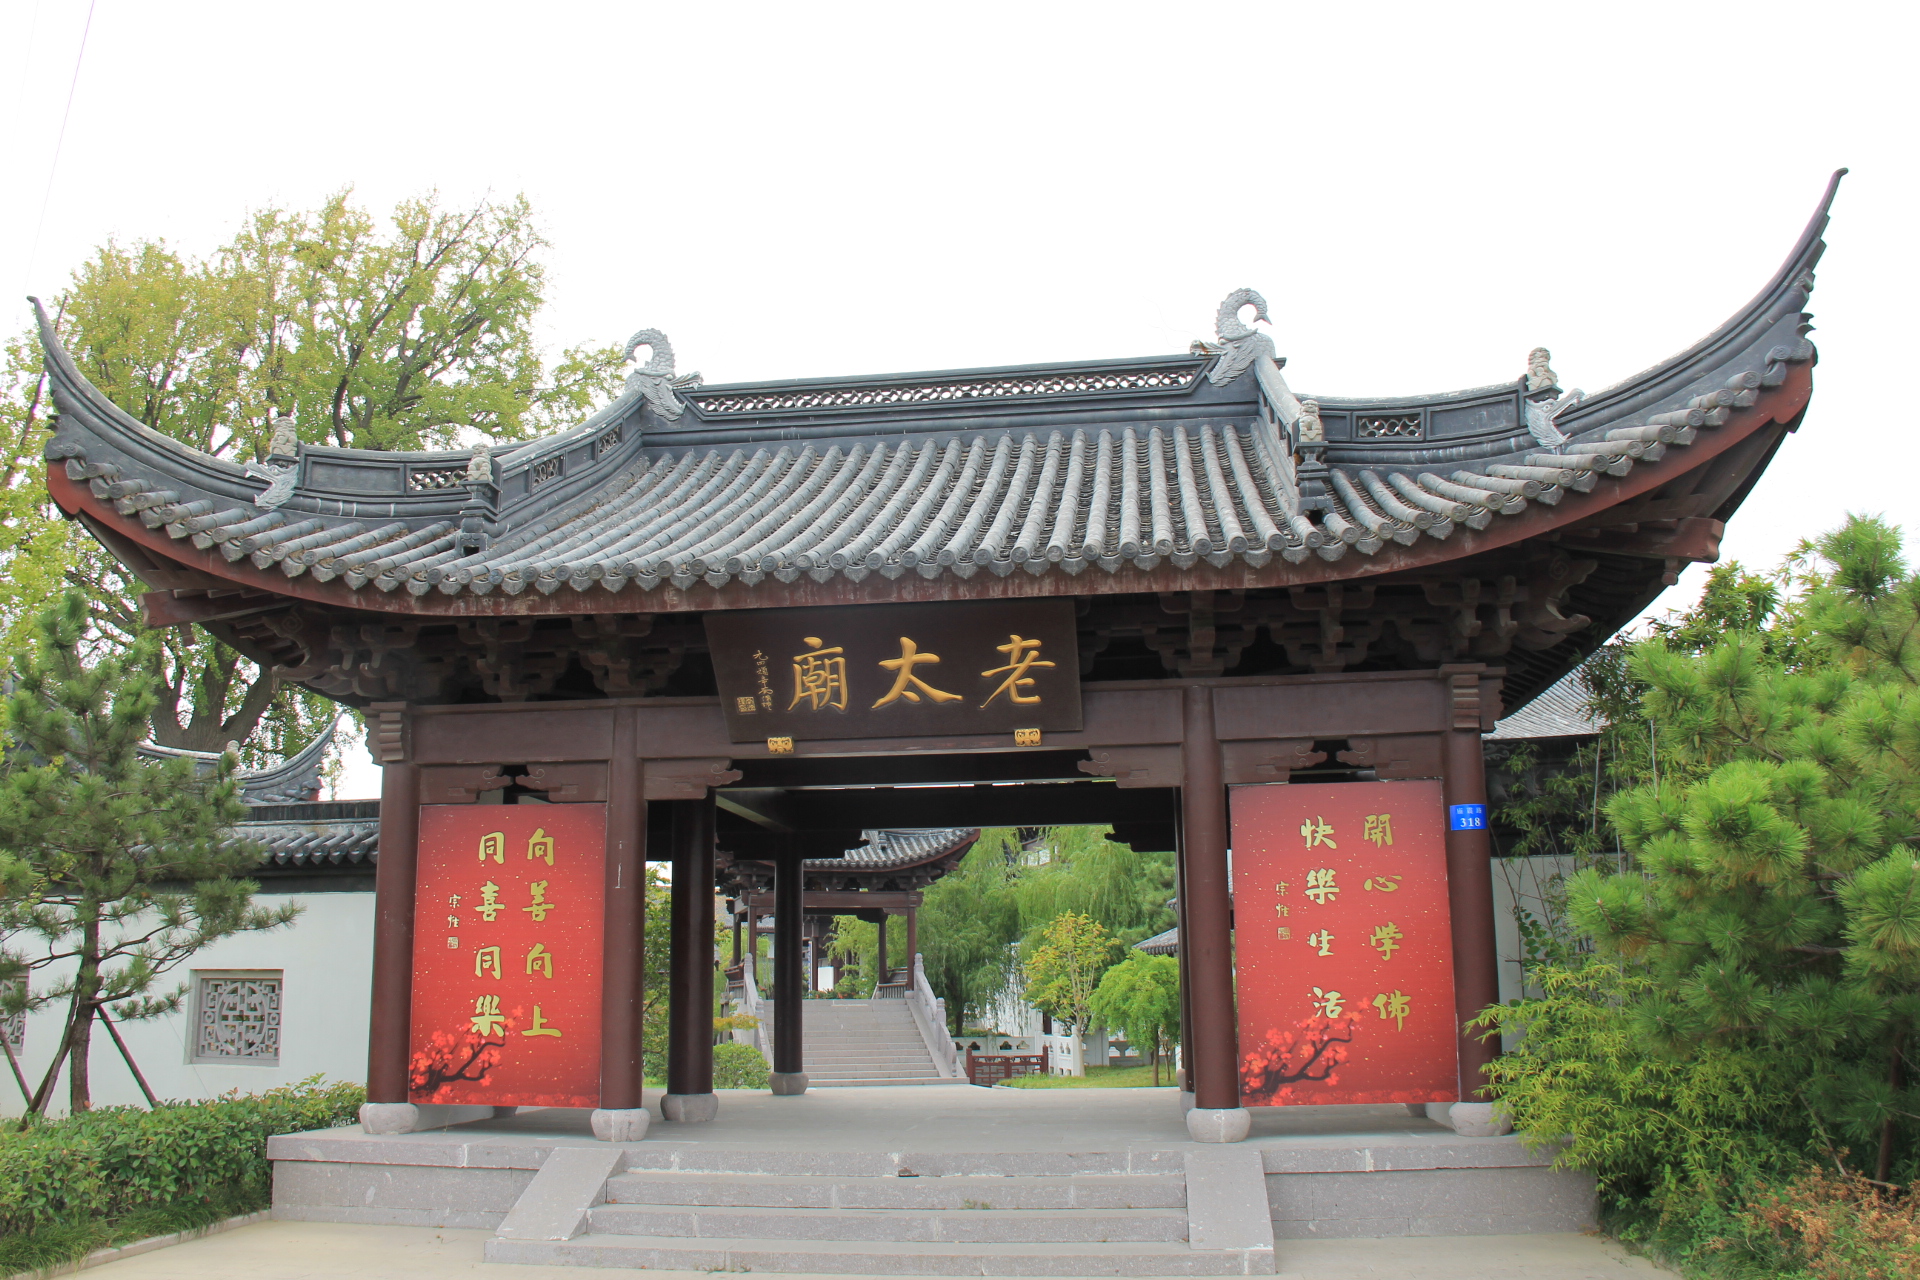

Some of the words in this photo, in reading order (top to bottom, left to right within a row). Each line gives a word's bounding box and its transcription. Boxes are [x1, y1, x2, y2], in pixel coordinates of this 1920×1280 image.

[1300, 815, 1346, 1019] 快樂生活
[1460, 817, 1482, 828] 318
[470, 831, 506, 1038] 同喜同樂
[521, 828, 562, 1038] 向善向上
